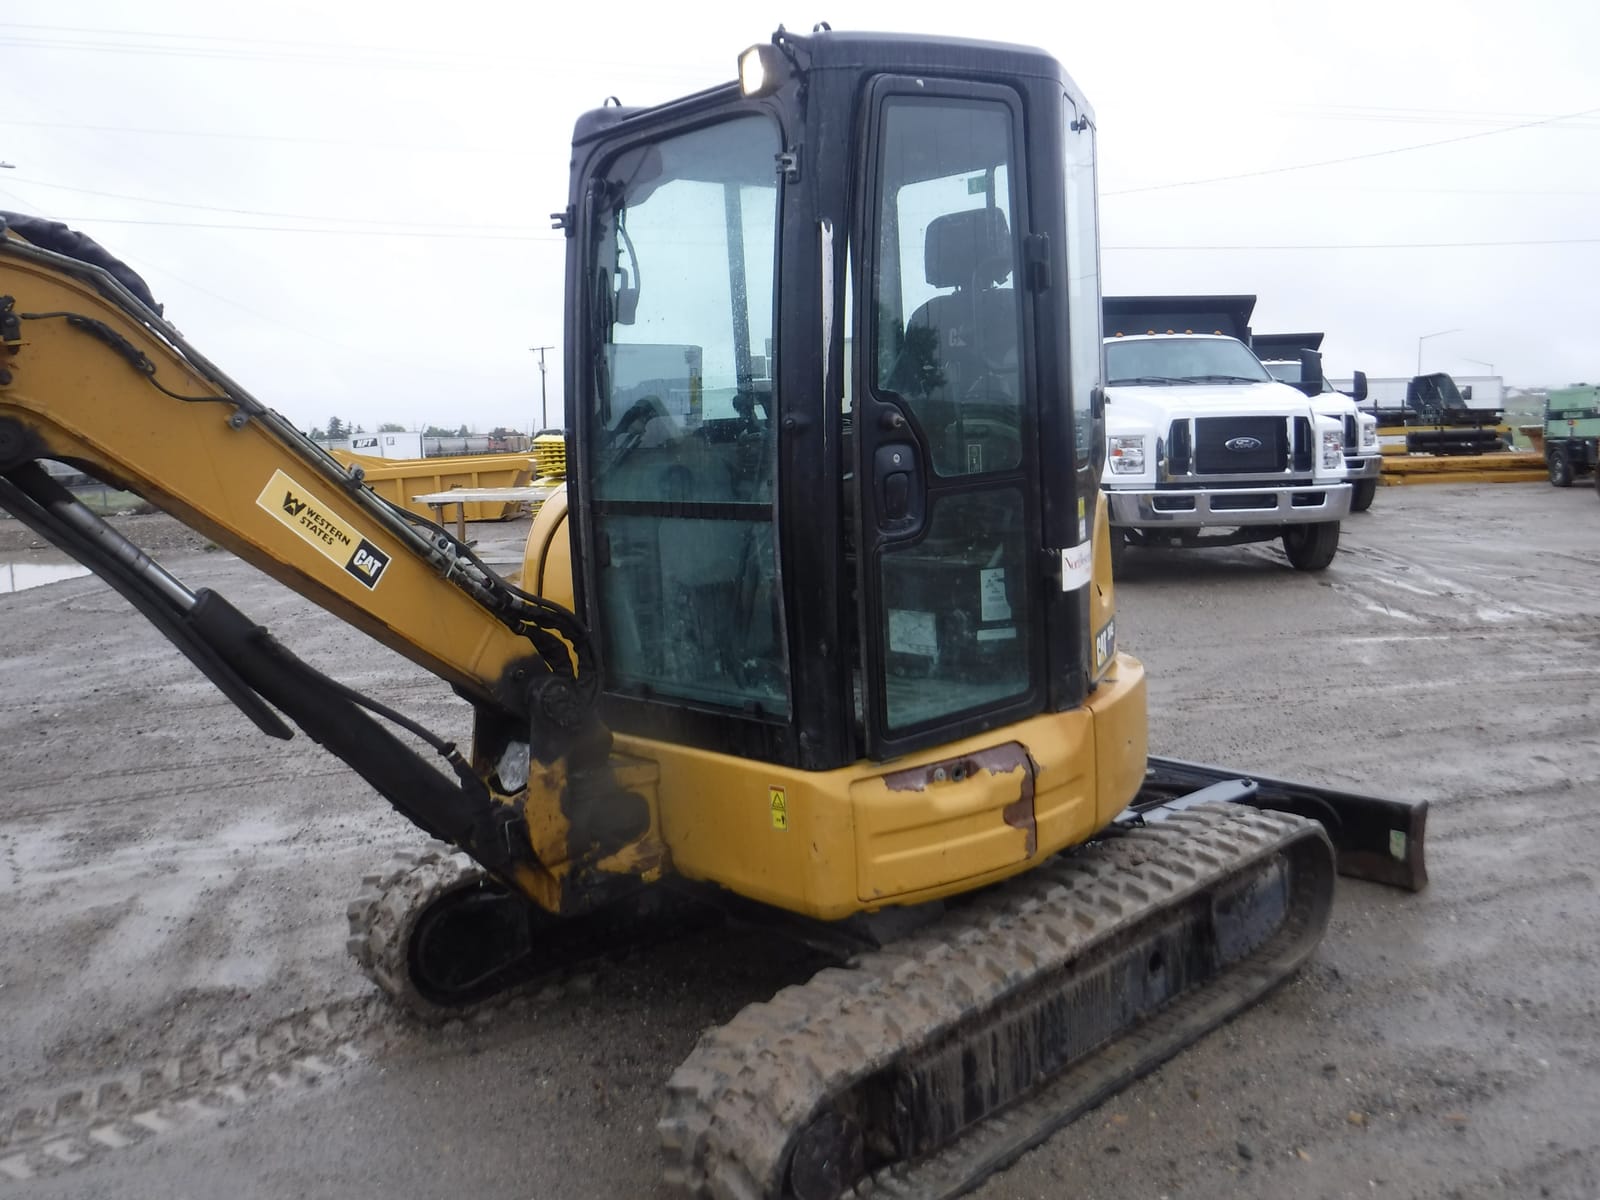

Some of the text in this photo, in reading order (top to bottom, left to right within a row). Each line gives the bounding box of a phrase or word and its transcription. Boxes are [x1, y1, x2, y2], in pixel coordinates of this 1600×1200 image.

[1231, 438, 1258, 450] Ford
[300, 516, 335, 546] STATES
[306, 507, 351, 546] WESTERN
[353, 549, 382, 577] CAT
